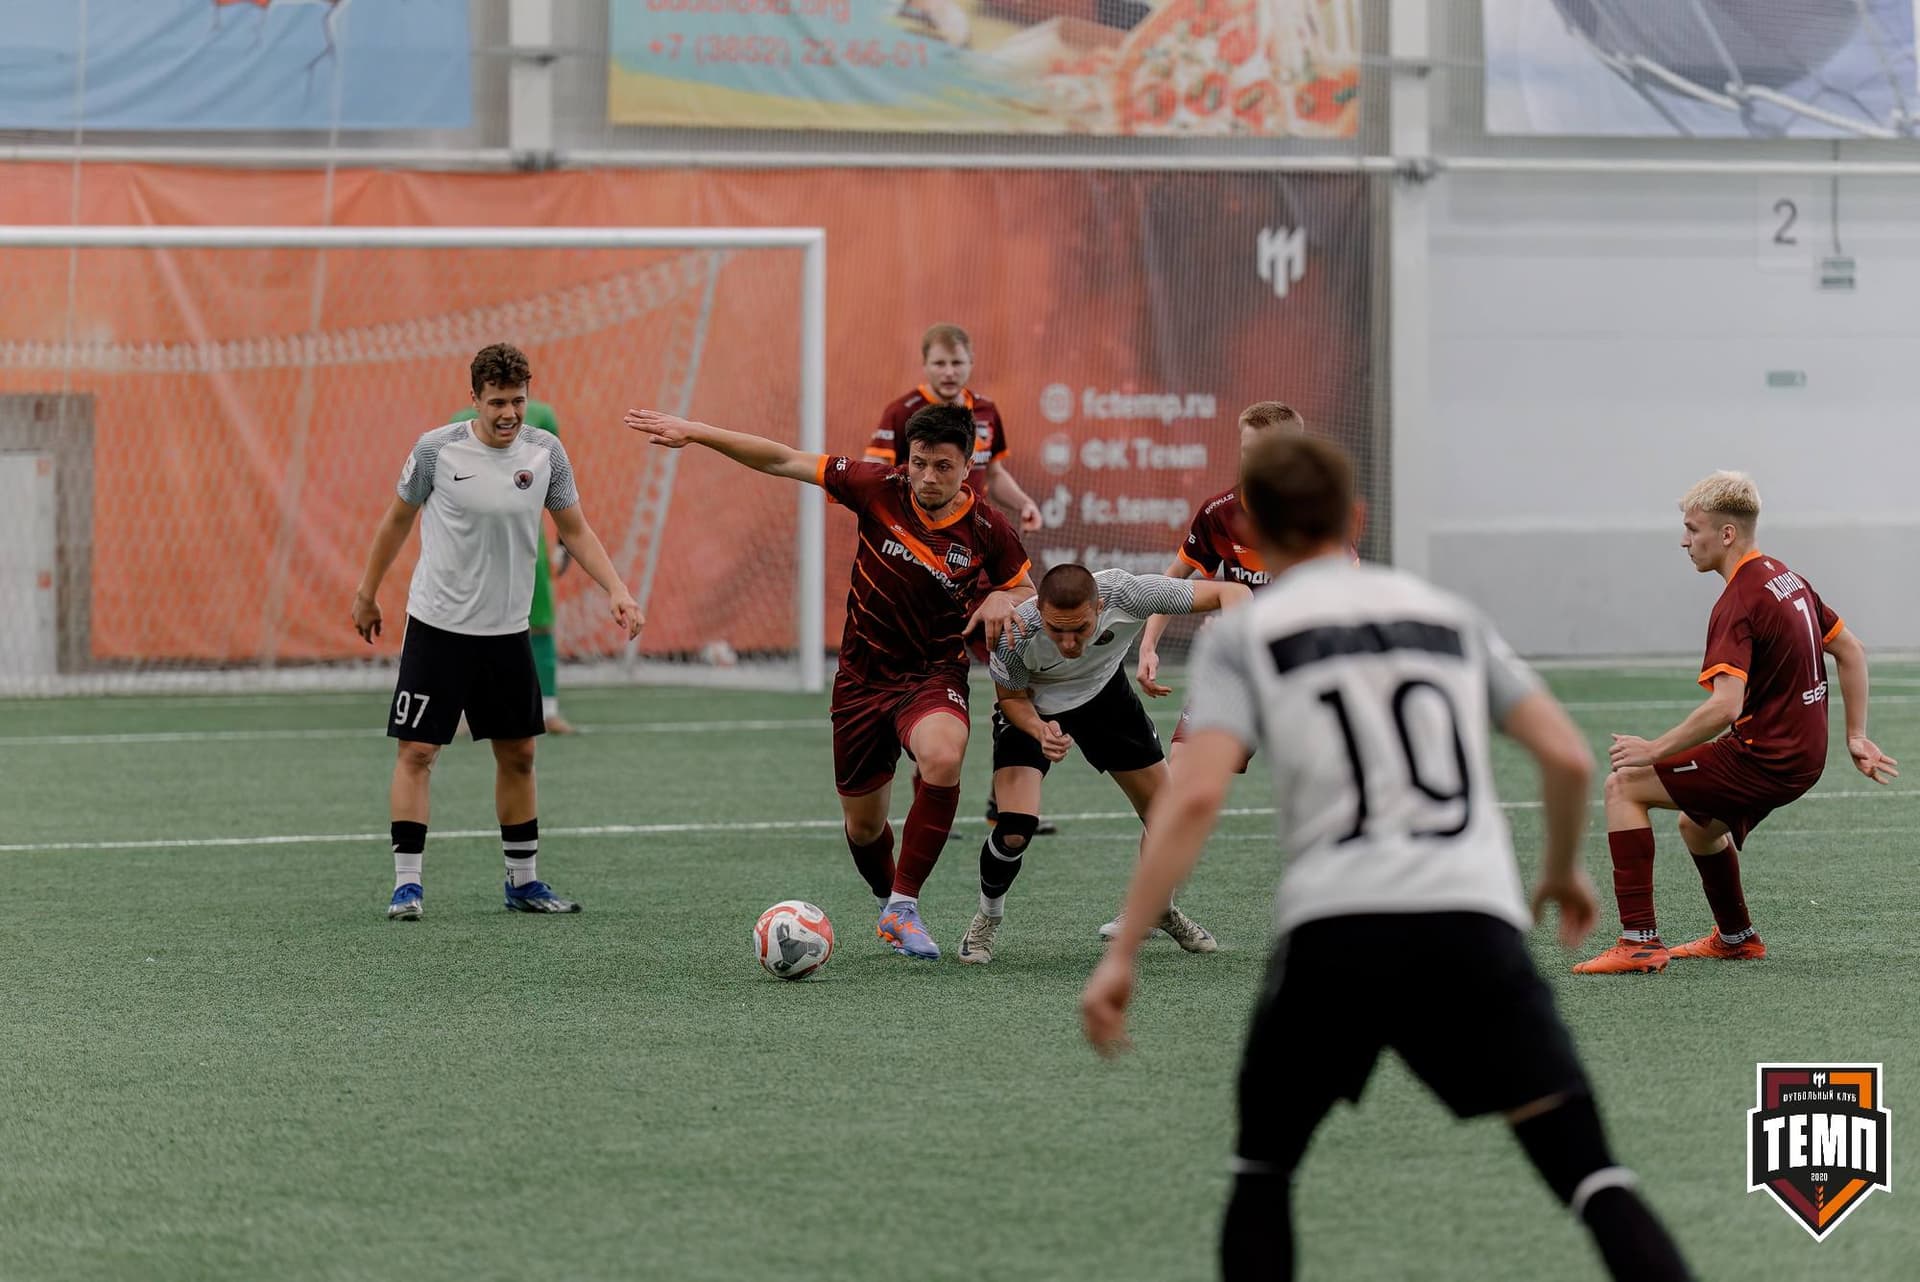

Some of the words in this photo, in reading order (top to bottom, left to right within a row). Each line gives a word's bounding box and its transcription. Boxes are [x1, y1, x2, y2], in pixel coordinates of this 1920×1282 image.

[649, 33, 684, 61] +7
[1773, 198, 1798, 246] 2
[1082, 386, 1217, 426] fctemp.ru
[1082, 491, 1189, 530] fc.temp
[948, 552, 969, 568] ТЕМП
[395, 691, 430, 728] 97
[1318, 680, 1471, 845] 19
